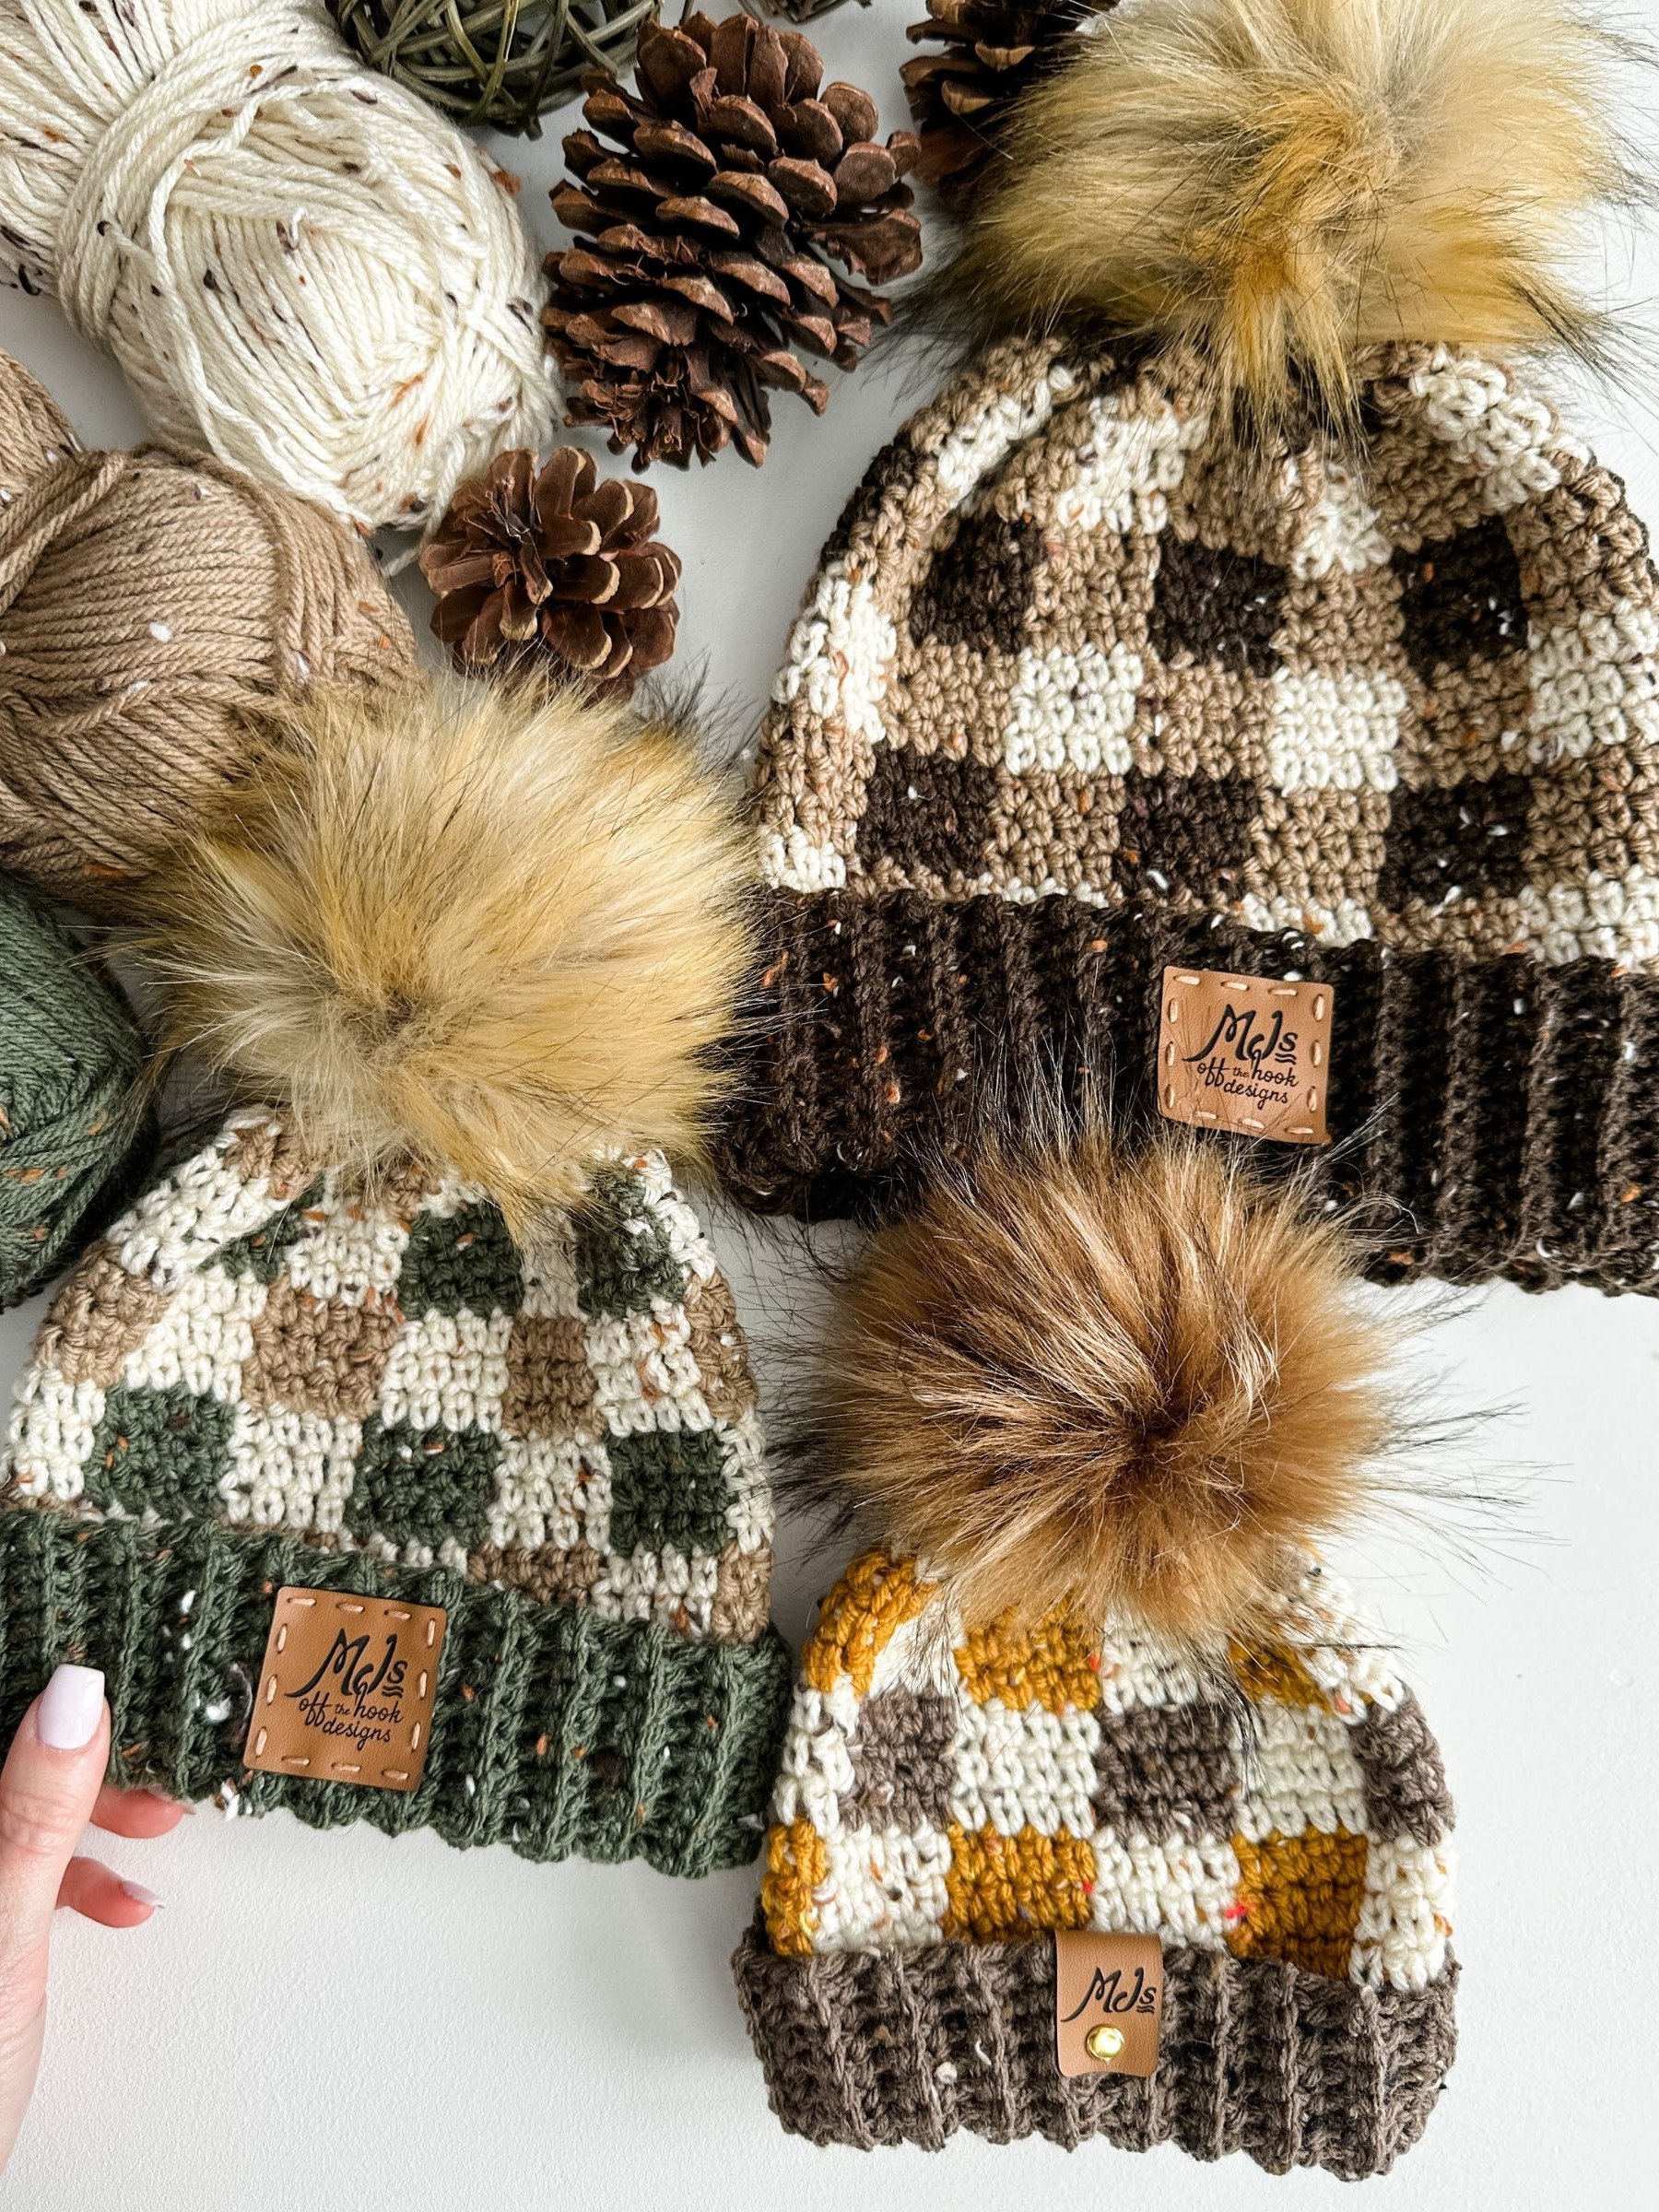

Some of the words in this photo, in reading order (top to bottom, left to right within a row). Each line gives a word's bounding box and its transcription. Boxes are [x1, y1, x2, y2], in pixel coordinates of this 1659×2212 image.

[1197, 1057, 1230, 1087] off
[1233, 1065, 1249, 1078] the
[1252, 1050, 1299, 1088] hook
[1224, 1078, 1288, 1111] designs
[299, 1690, 333, 1726] off
[335, 1703, 351, 1715] the
[354, 1682, 404, 1724] hook
[323, 1714, 391, 1751] designs
